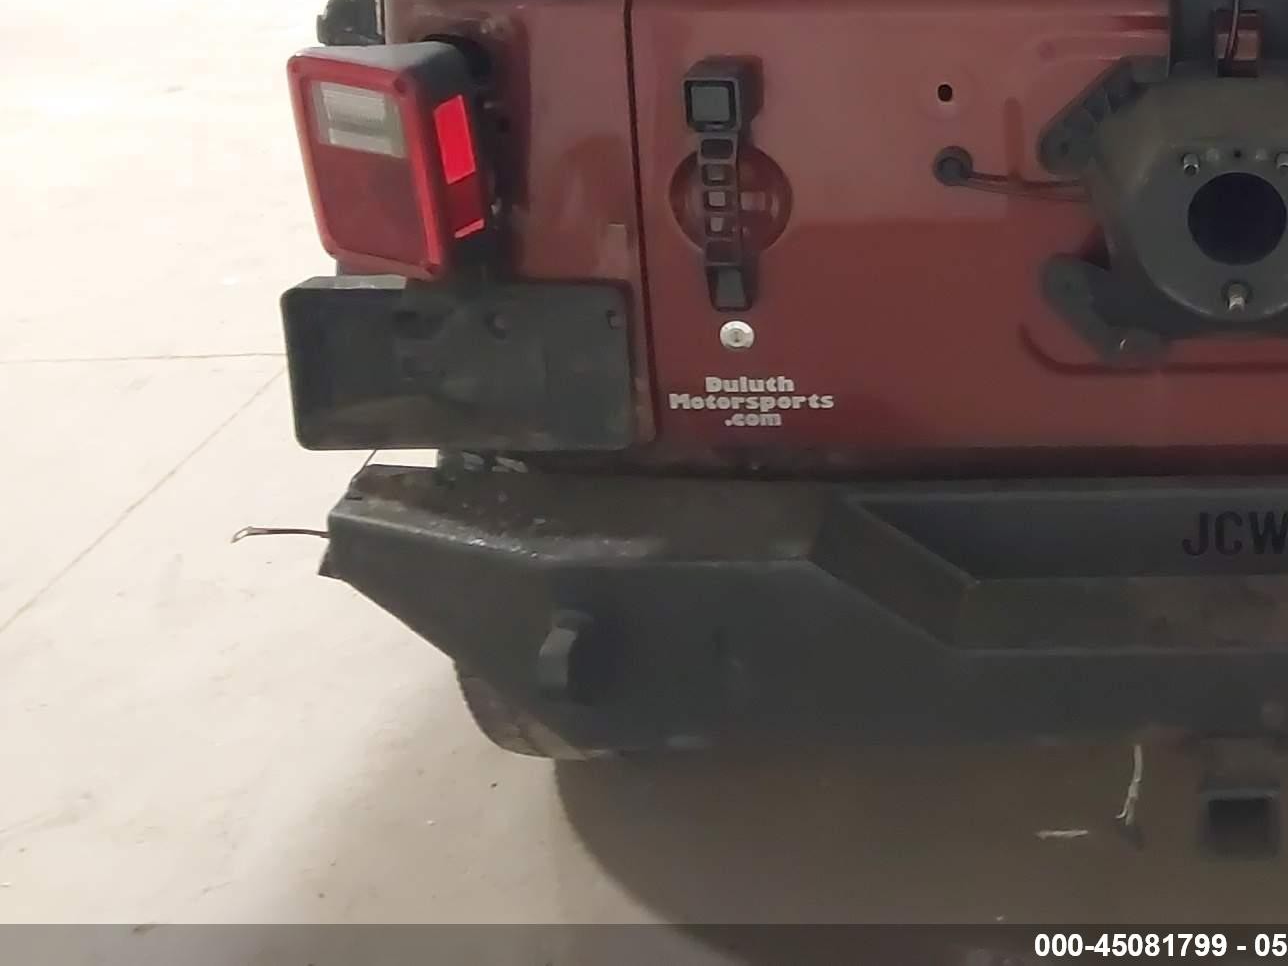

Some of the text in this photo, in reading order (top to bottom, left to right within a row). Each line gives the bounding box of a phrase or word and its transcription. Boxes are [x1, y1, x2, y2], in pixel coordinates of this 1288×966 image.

[705, 376, 795, 392] Duluth
[669, 393, 834, 412] Motorsports
[724, 413, 782, 427] .com
